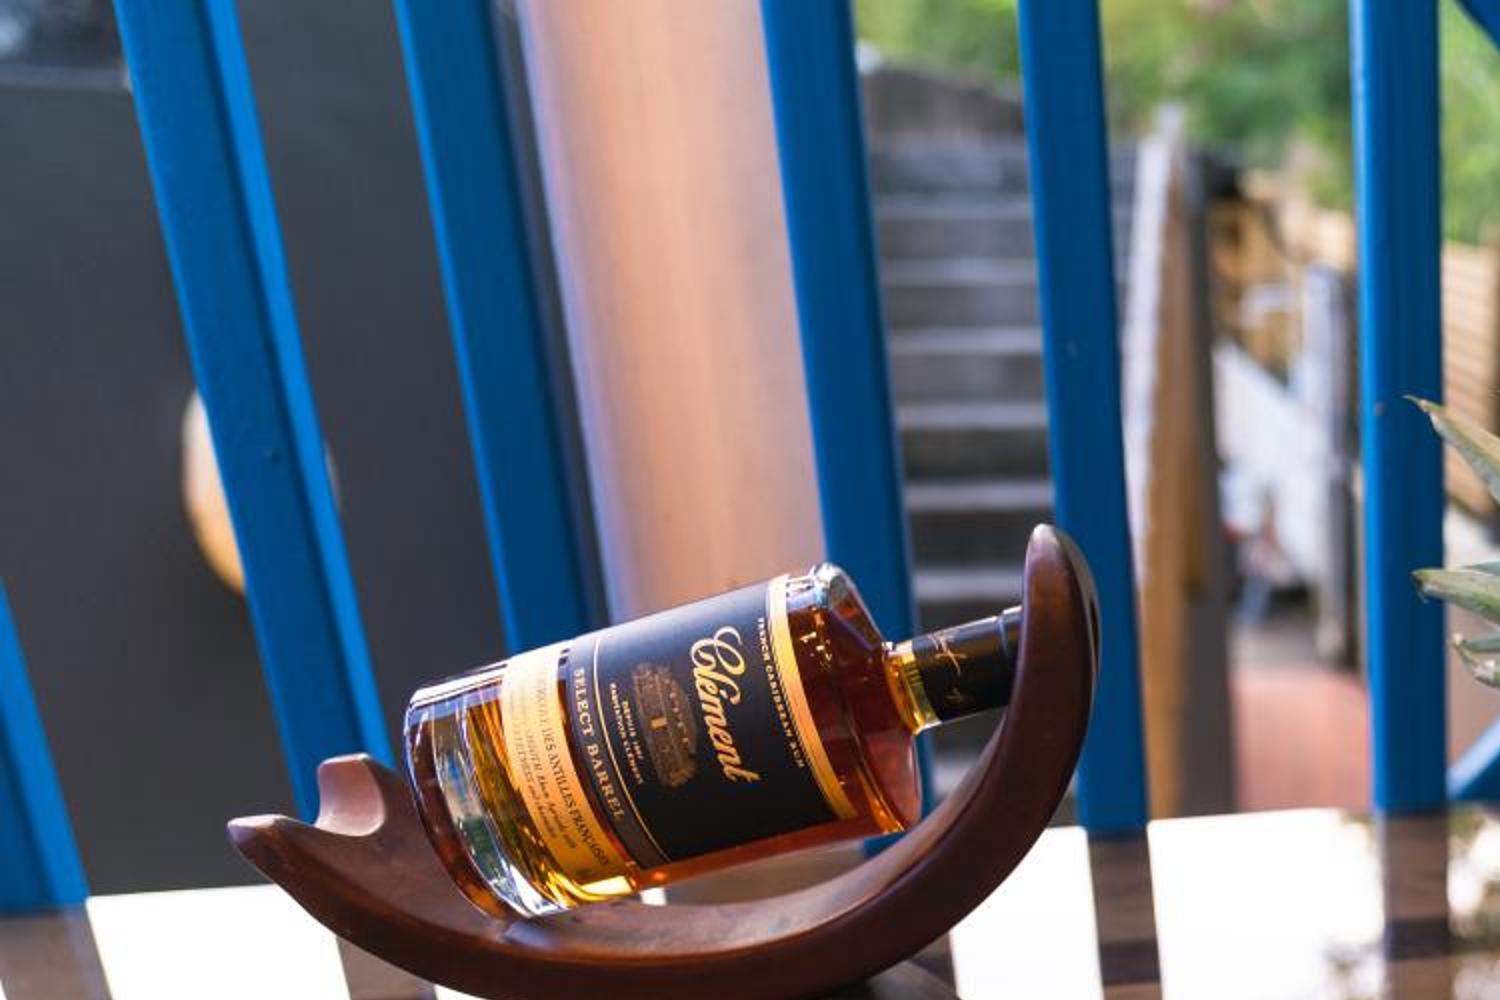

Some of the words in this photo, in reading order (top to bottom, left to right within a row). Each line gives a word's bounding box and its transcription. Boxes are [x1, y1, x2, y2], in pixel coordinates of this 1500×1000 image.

[573, 668, 594, 737] SELECT
[586, 743, 625, 822] BARREL
[691, 626, 761, 782] Clément
[766, 665, 793, 737] CARIBBEAN
[789, 741, 805, 768] RUM
[549, 752, 577, 809] ANTILLES
